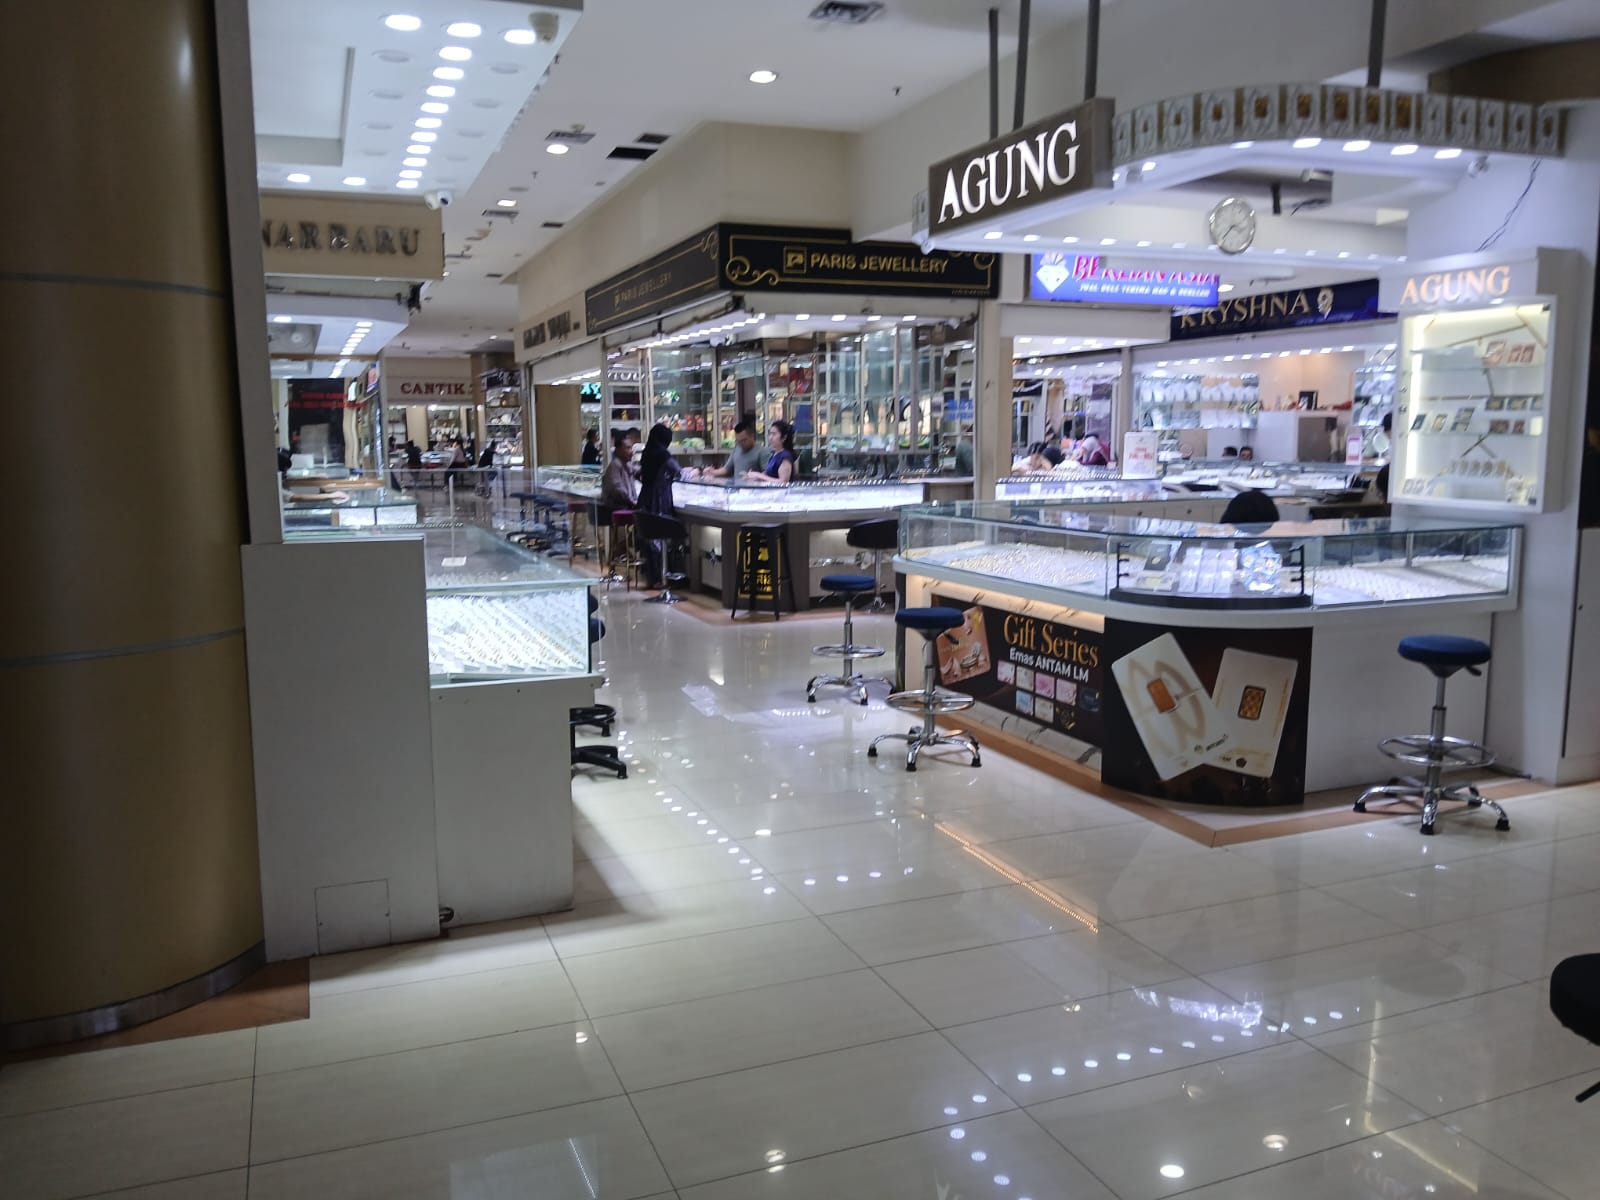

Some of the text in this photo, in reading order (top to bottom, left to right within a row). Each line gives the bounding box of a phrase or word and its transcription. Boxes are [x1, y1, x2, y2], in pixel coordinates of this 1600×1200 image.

[937, 120, 1080, 224] AGUNG
[811, 253, 856, 270] PARIS
[860, 255, 948, 274] JEWELLERY
[1400, 265, 1511, 304] AGUNG
[1181, 289, 1310, 329] KRYSHNA
[400, 382, 465, 395] CANTIK
[1003, 614, 1098, 668] Gift Series
[1009, 647, 1090, 684] Emas ANTAM LM
